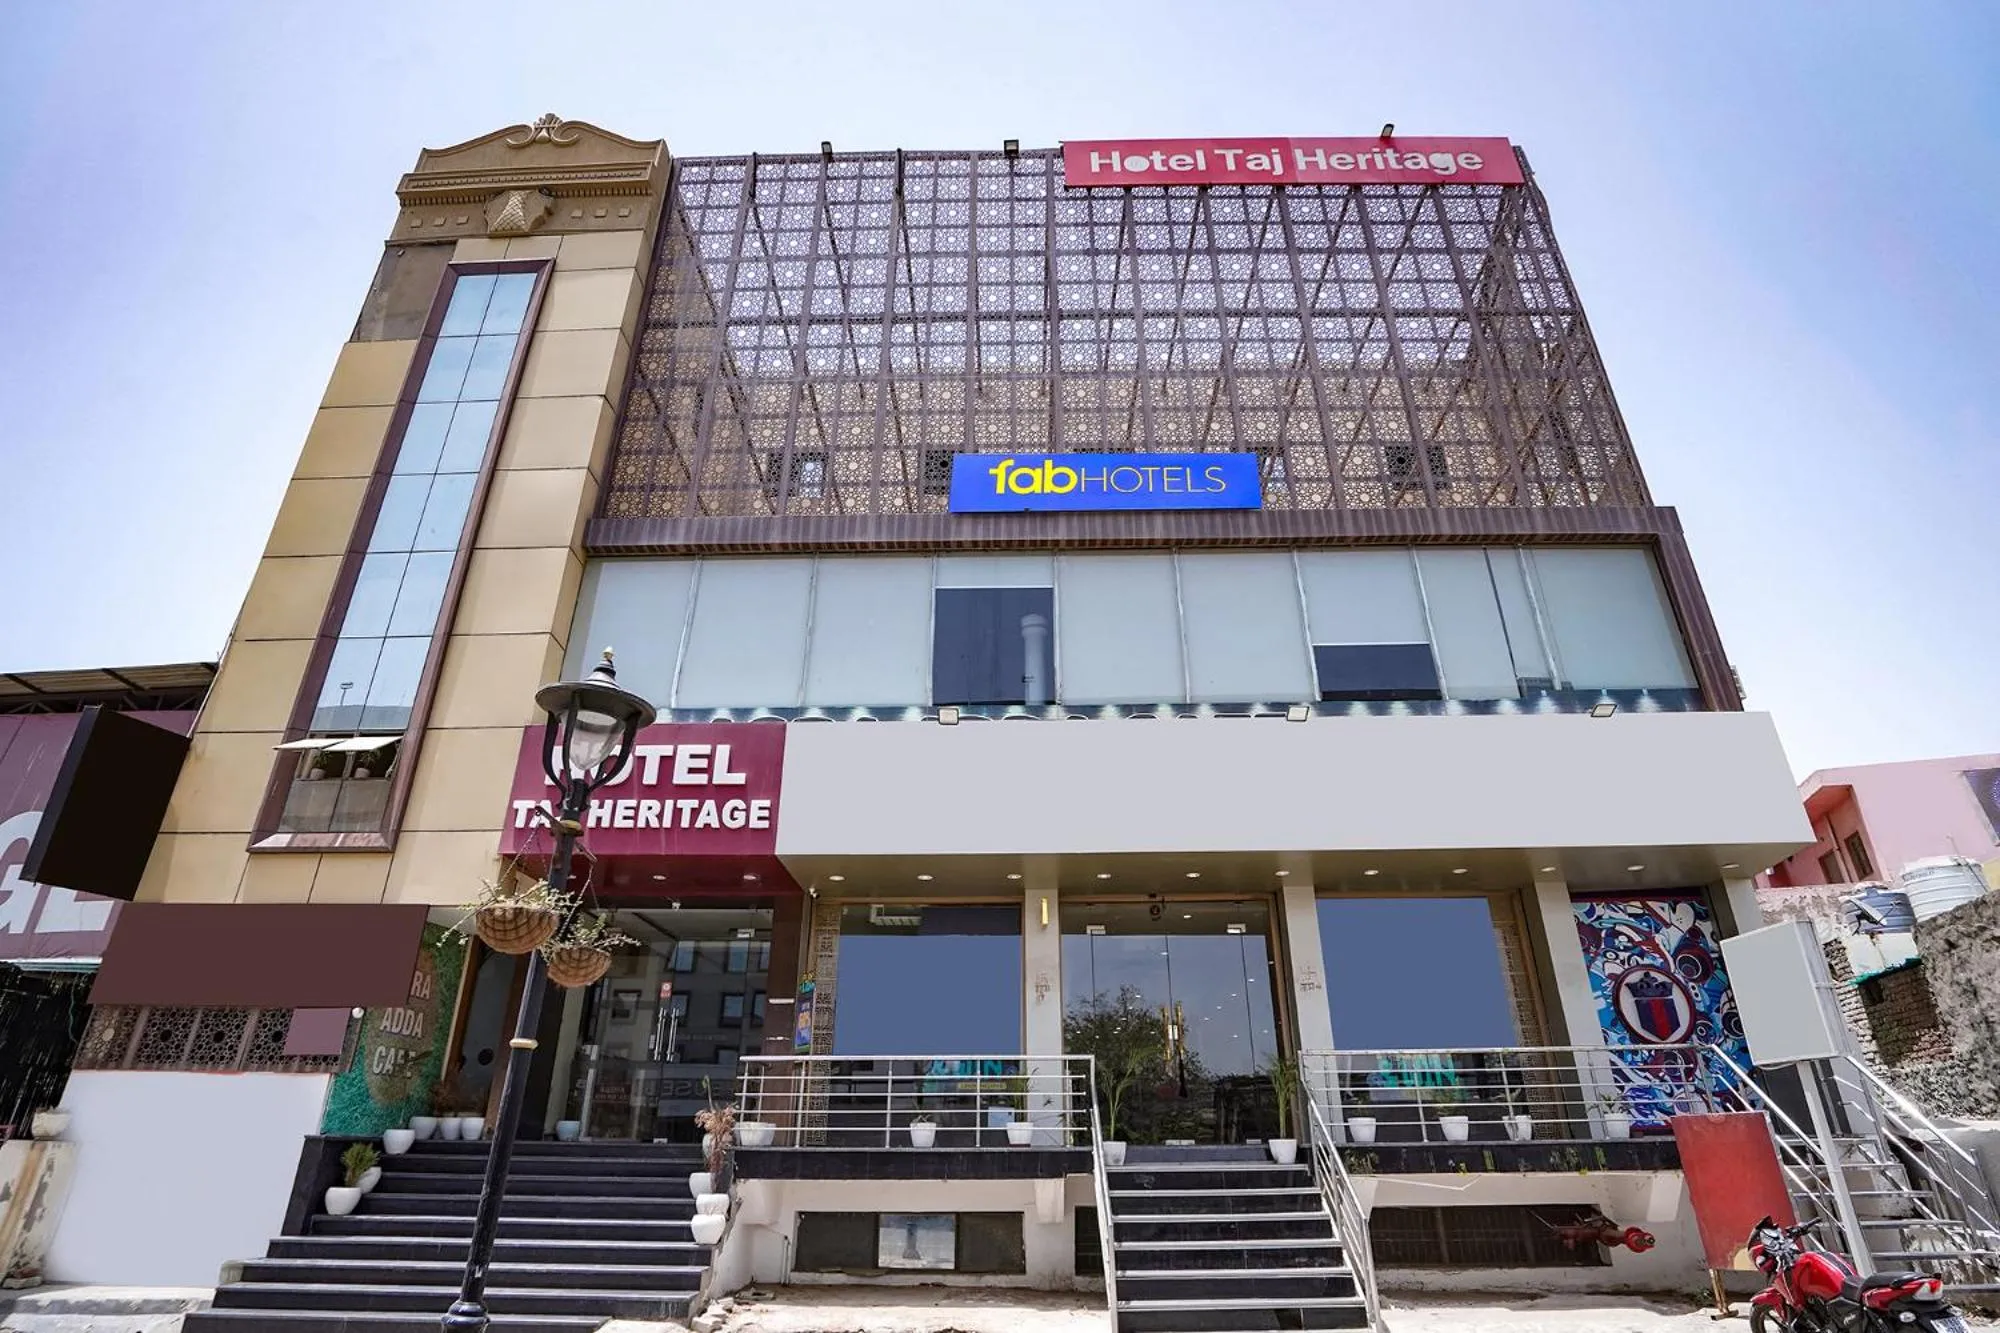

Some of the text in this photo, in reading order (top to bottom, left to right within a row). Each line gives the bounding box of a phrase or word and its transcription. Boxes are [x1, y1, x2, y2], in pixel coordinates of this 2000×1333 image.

[1090, 148, 1484, 176] Hotel Taj Heritage
[989, 459, 1226, 495] fabHOTELS
[512, 799, 771, 829] TA HERITAGE
[380, 1007, 424, 1039] ADDA
